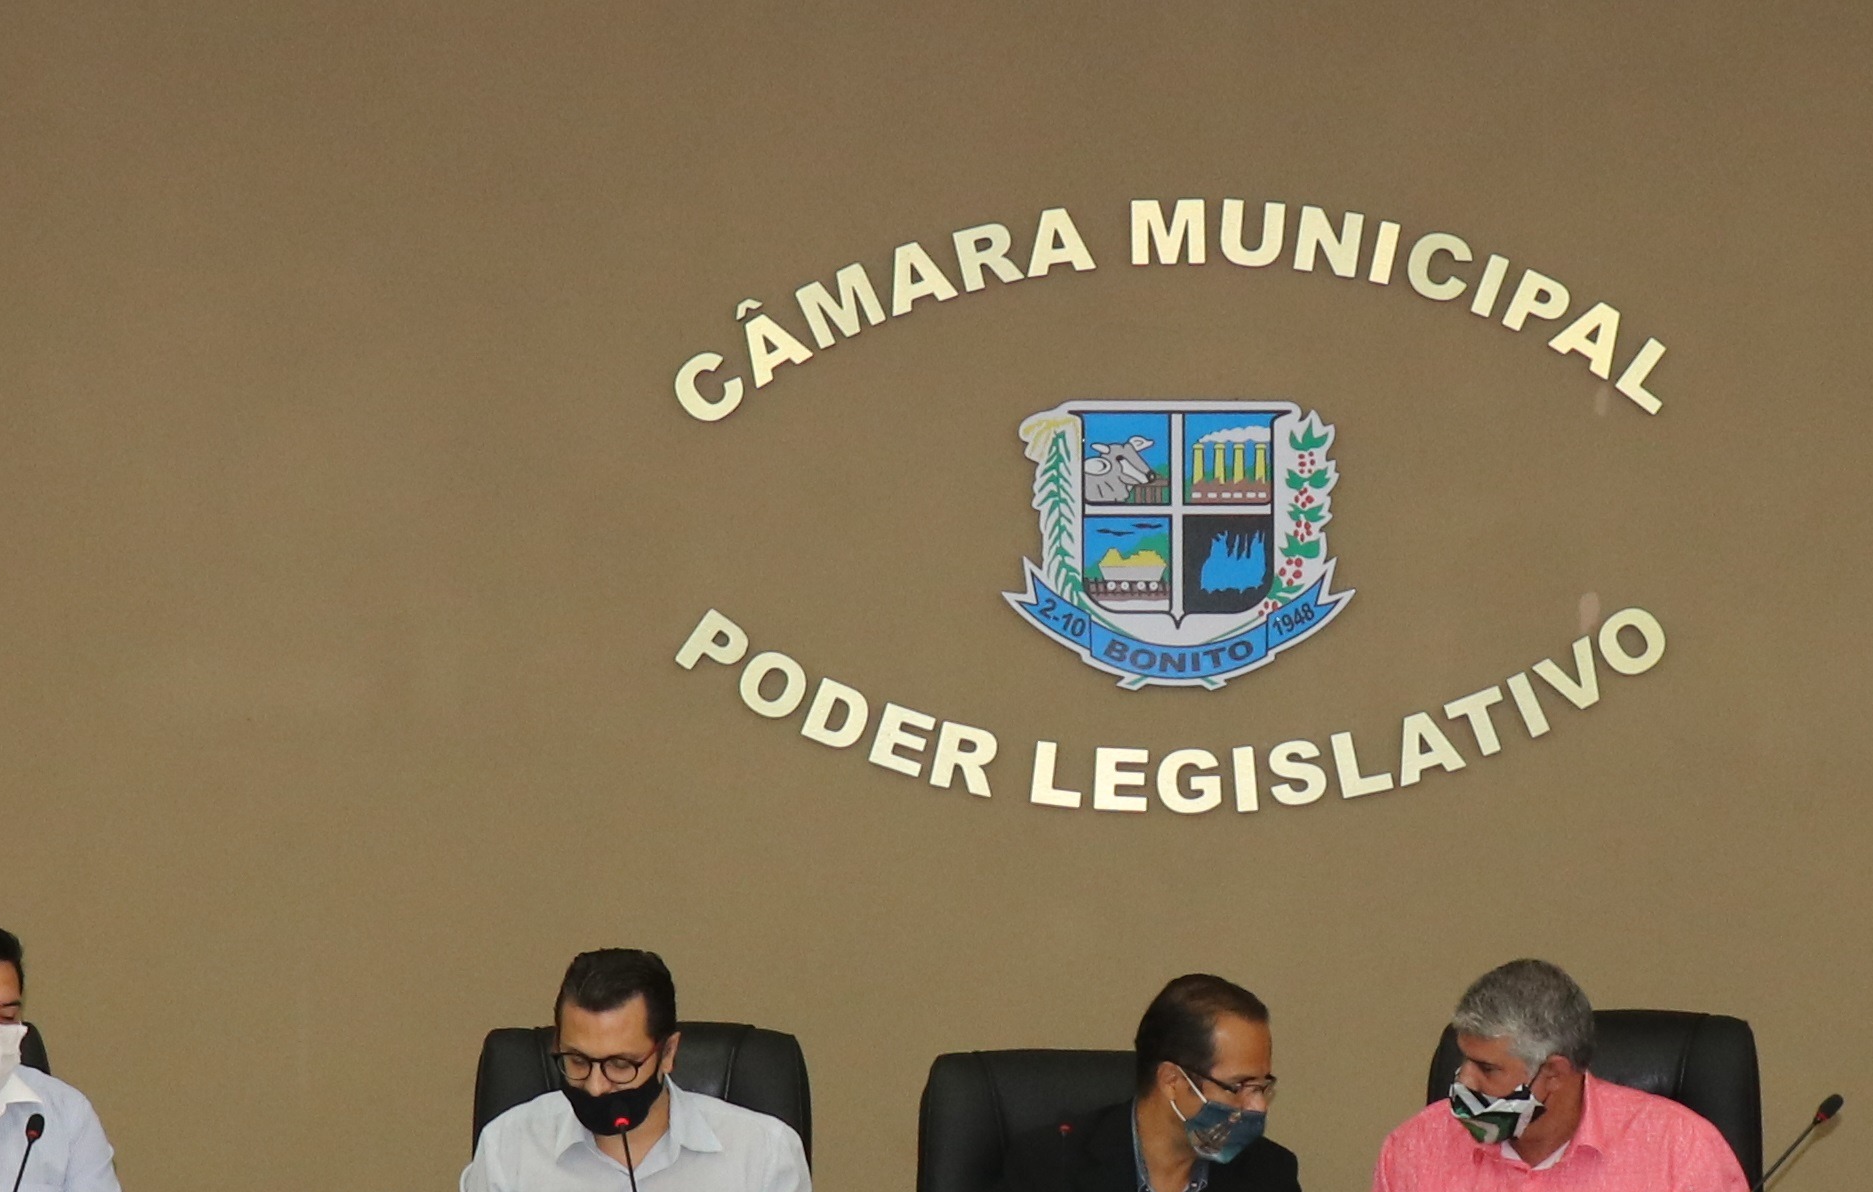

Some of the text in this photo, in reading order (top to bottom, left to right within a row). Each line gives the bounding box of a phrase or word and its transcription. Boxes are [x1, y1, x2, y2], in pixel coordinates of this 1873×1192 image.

[674, 198, 1669, 422] CÂMARA MUNICIPAL
[674, 607, 1666, 815] PODER LEGISLATIVO
[1103, 639, 1253, 672] BONITO
[1272, 602, 1315, 636] 1948
